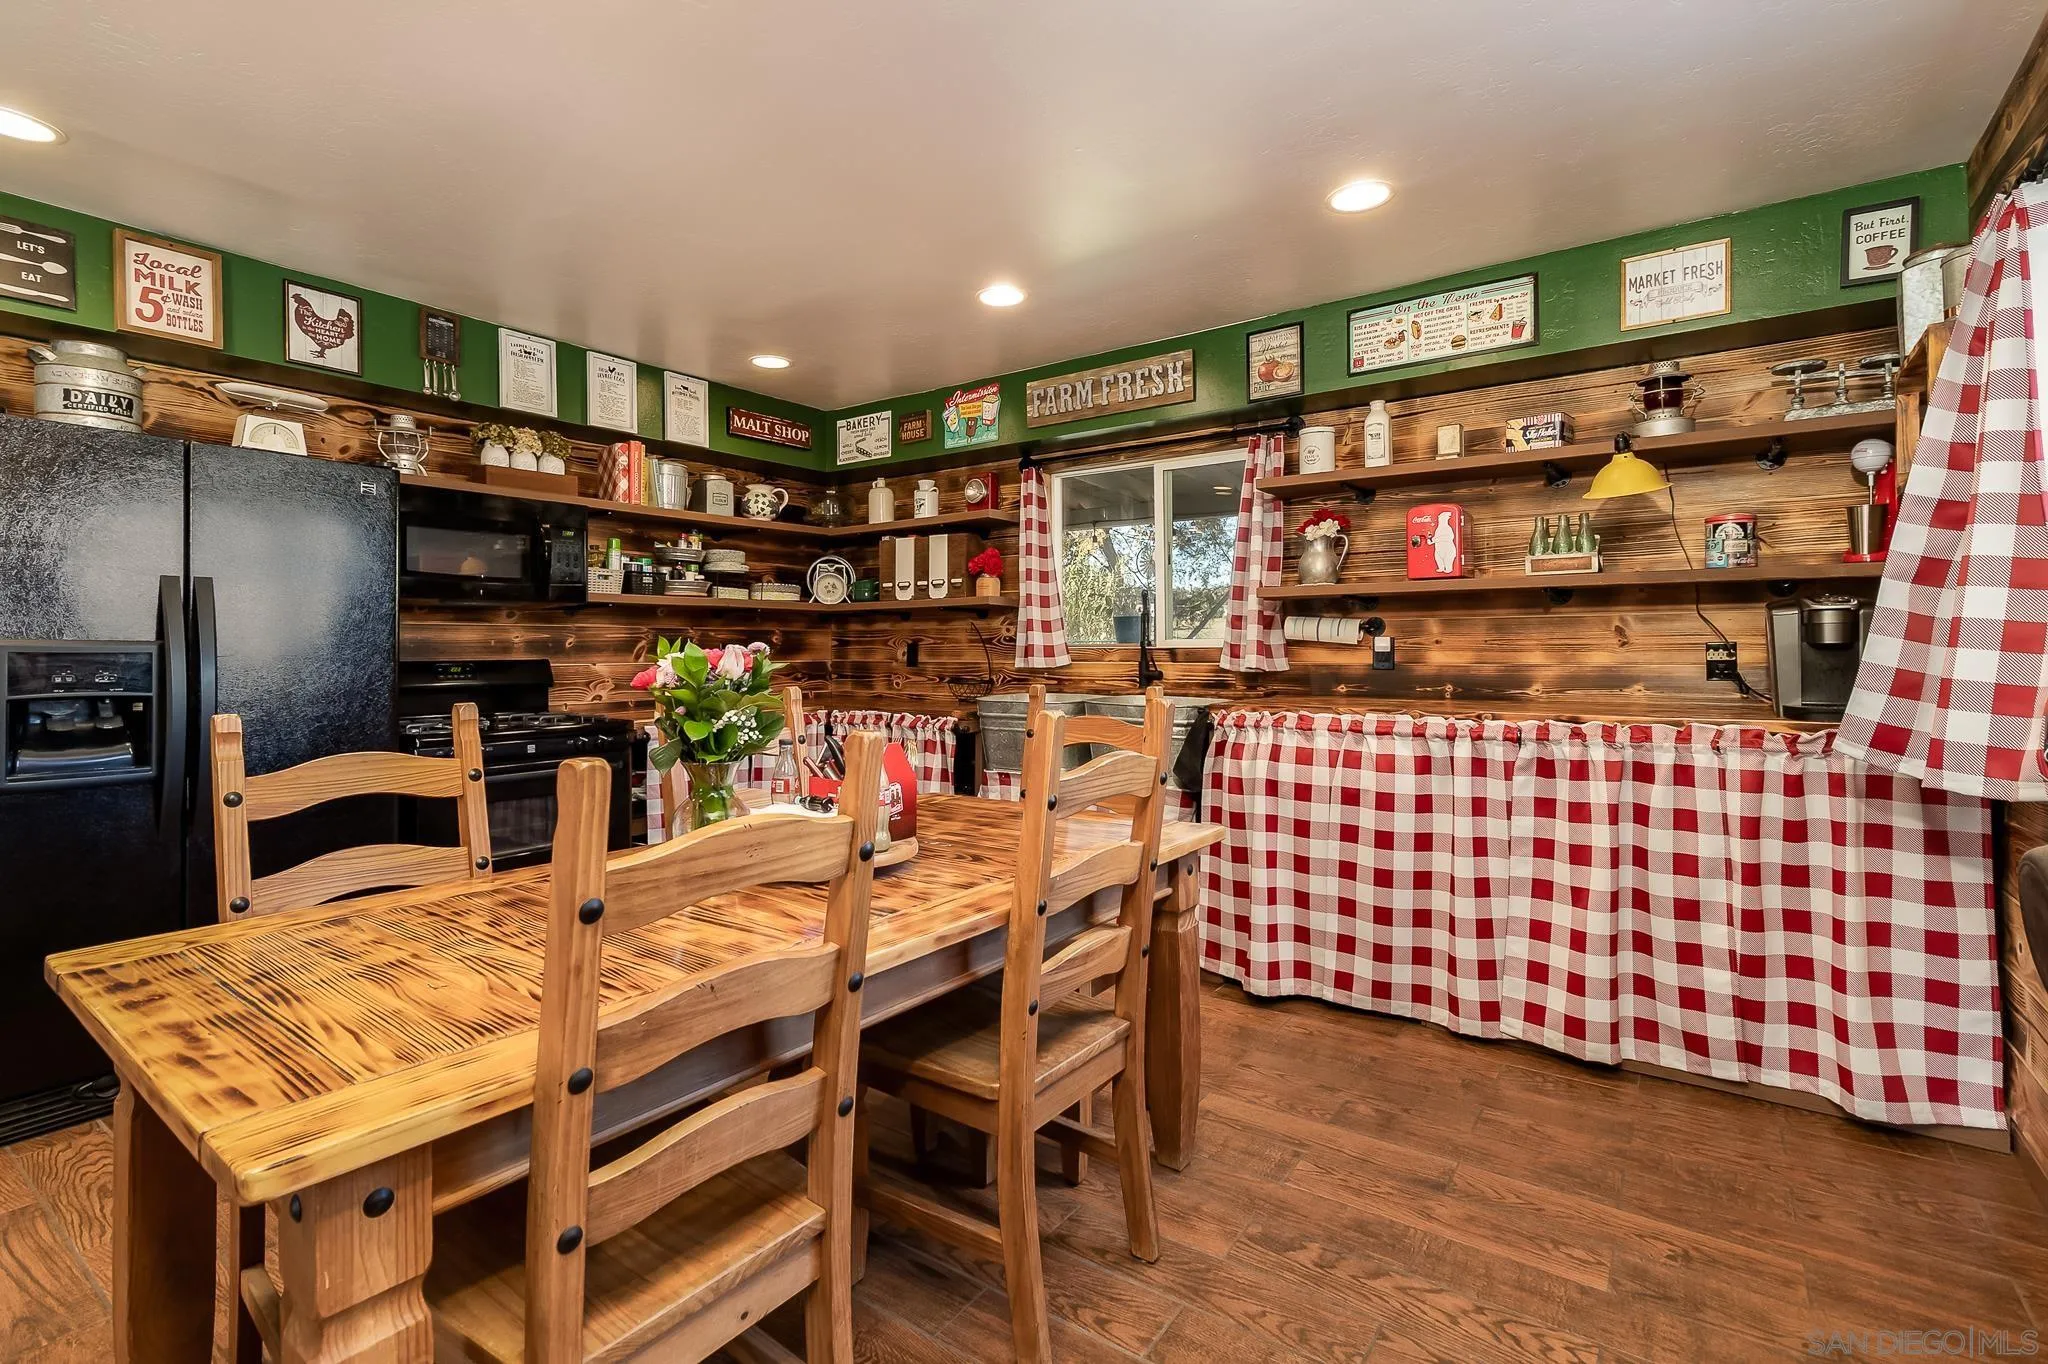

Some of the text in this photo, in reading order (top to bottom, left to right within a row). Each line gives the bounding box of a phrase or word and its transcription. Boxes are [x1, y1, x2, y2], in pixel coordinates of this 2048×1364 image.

[1854, 220, 1875, 232] But
[1855, 227, 1907, 245] COFFEE
[16, 240, 46, 255] LET'S
[133, 252, 203, 279] Local
[21, 271, 43, 283] EAT
[134, 267, 203, 298] MILK
[1628, 268, 1677, 294] MARKET
[1683, 259, 1724, 281] FRESH
[171, 292, 203, 311] WASH
[1393, 291, 1480, 315] On the Menu
[166, 313, 204, 333] BOTTLES
[303, 316, 346, 334] Kitchen
[315, 328, 339, 338] HEART
[316, 333, 342, 345] HOME
[948, 385, 999, 407] Intermission
[1031, 360, 1185, 418] FARM FRESH
[67, 402, 109, 412] CERTIFIED
[733, 414, 809, 442] MALT SHOP
[846, 413, 883, 431] BAKERY
[903, 419, 922, 431] FARM
[901, 428, 925, 441] HOUSE
